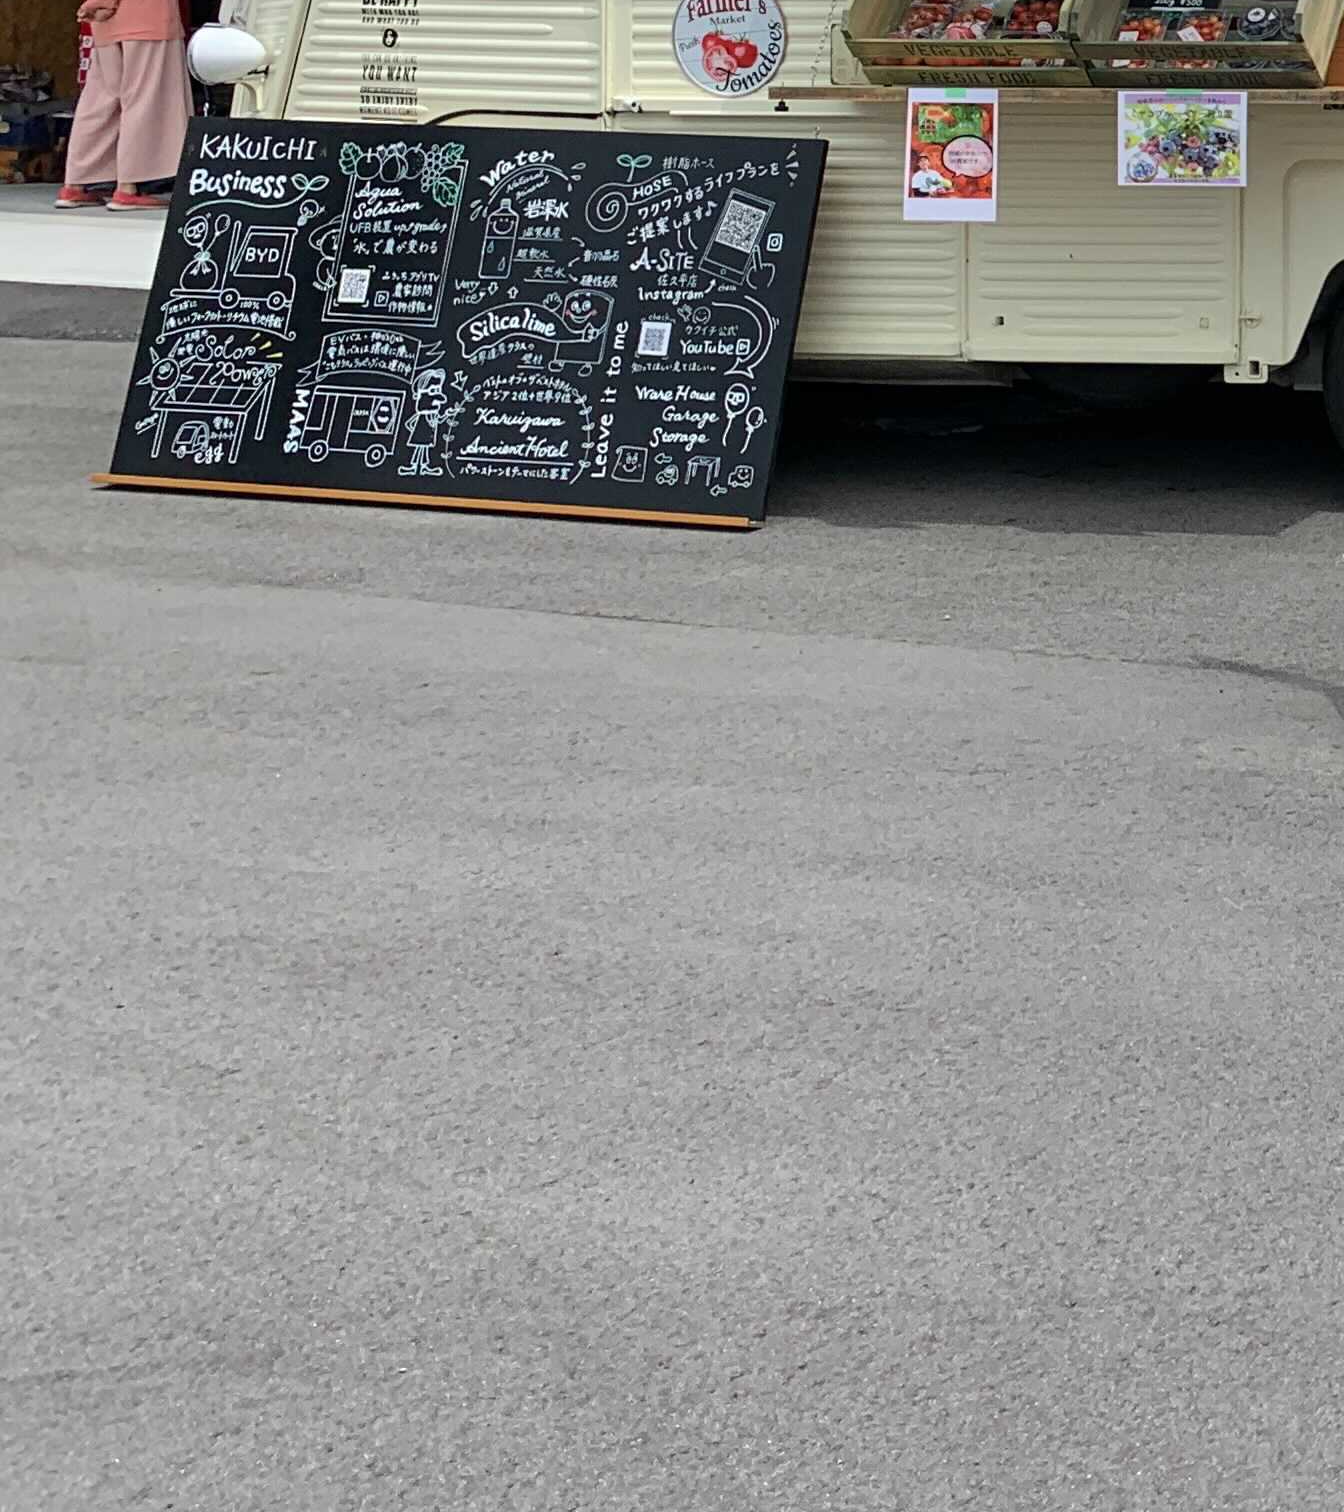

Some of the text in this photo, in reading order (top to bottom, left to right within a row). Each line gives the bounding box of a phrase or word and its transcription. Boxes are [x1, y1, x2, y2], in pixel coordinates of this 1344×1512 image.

[715, 21, 783, 92] Tomatoes
[479, 150, 555, 187] Water
[189, 168, 287, 199] Business
[355, 181, 403, 204] Aqua
[632, 175, 673, 201] HOSE
[353, 199, 424, 220] Solution
[245, 247, 280, 263] BYD
[638, 288, 704, 306] Instagram
[680, 339, 735, 356] YouTube
[590, 320, 629, 478] Leave it to me
[283, 389, 311, 453] MAAS
[473, 407, 567, 433] Karuizawa
[662, 405, 720, 428] Garage
[526, 436, 569, 458] Hotel
[649, 426, 711, 452] Storage
